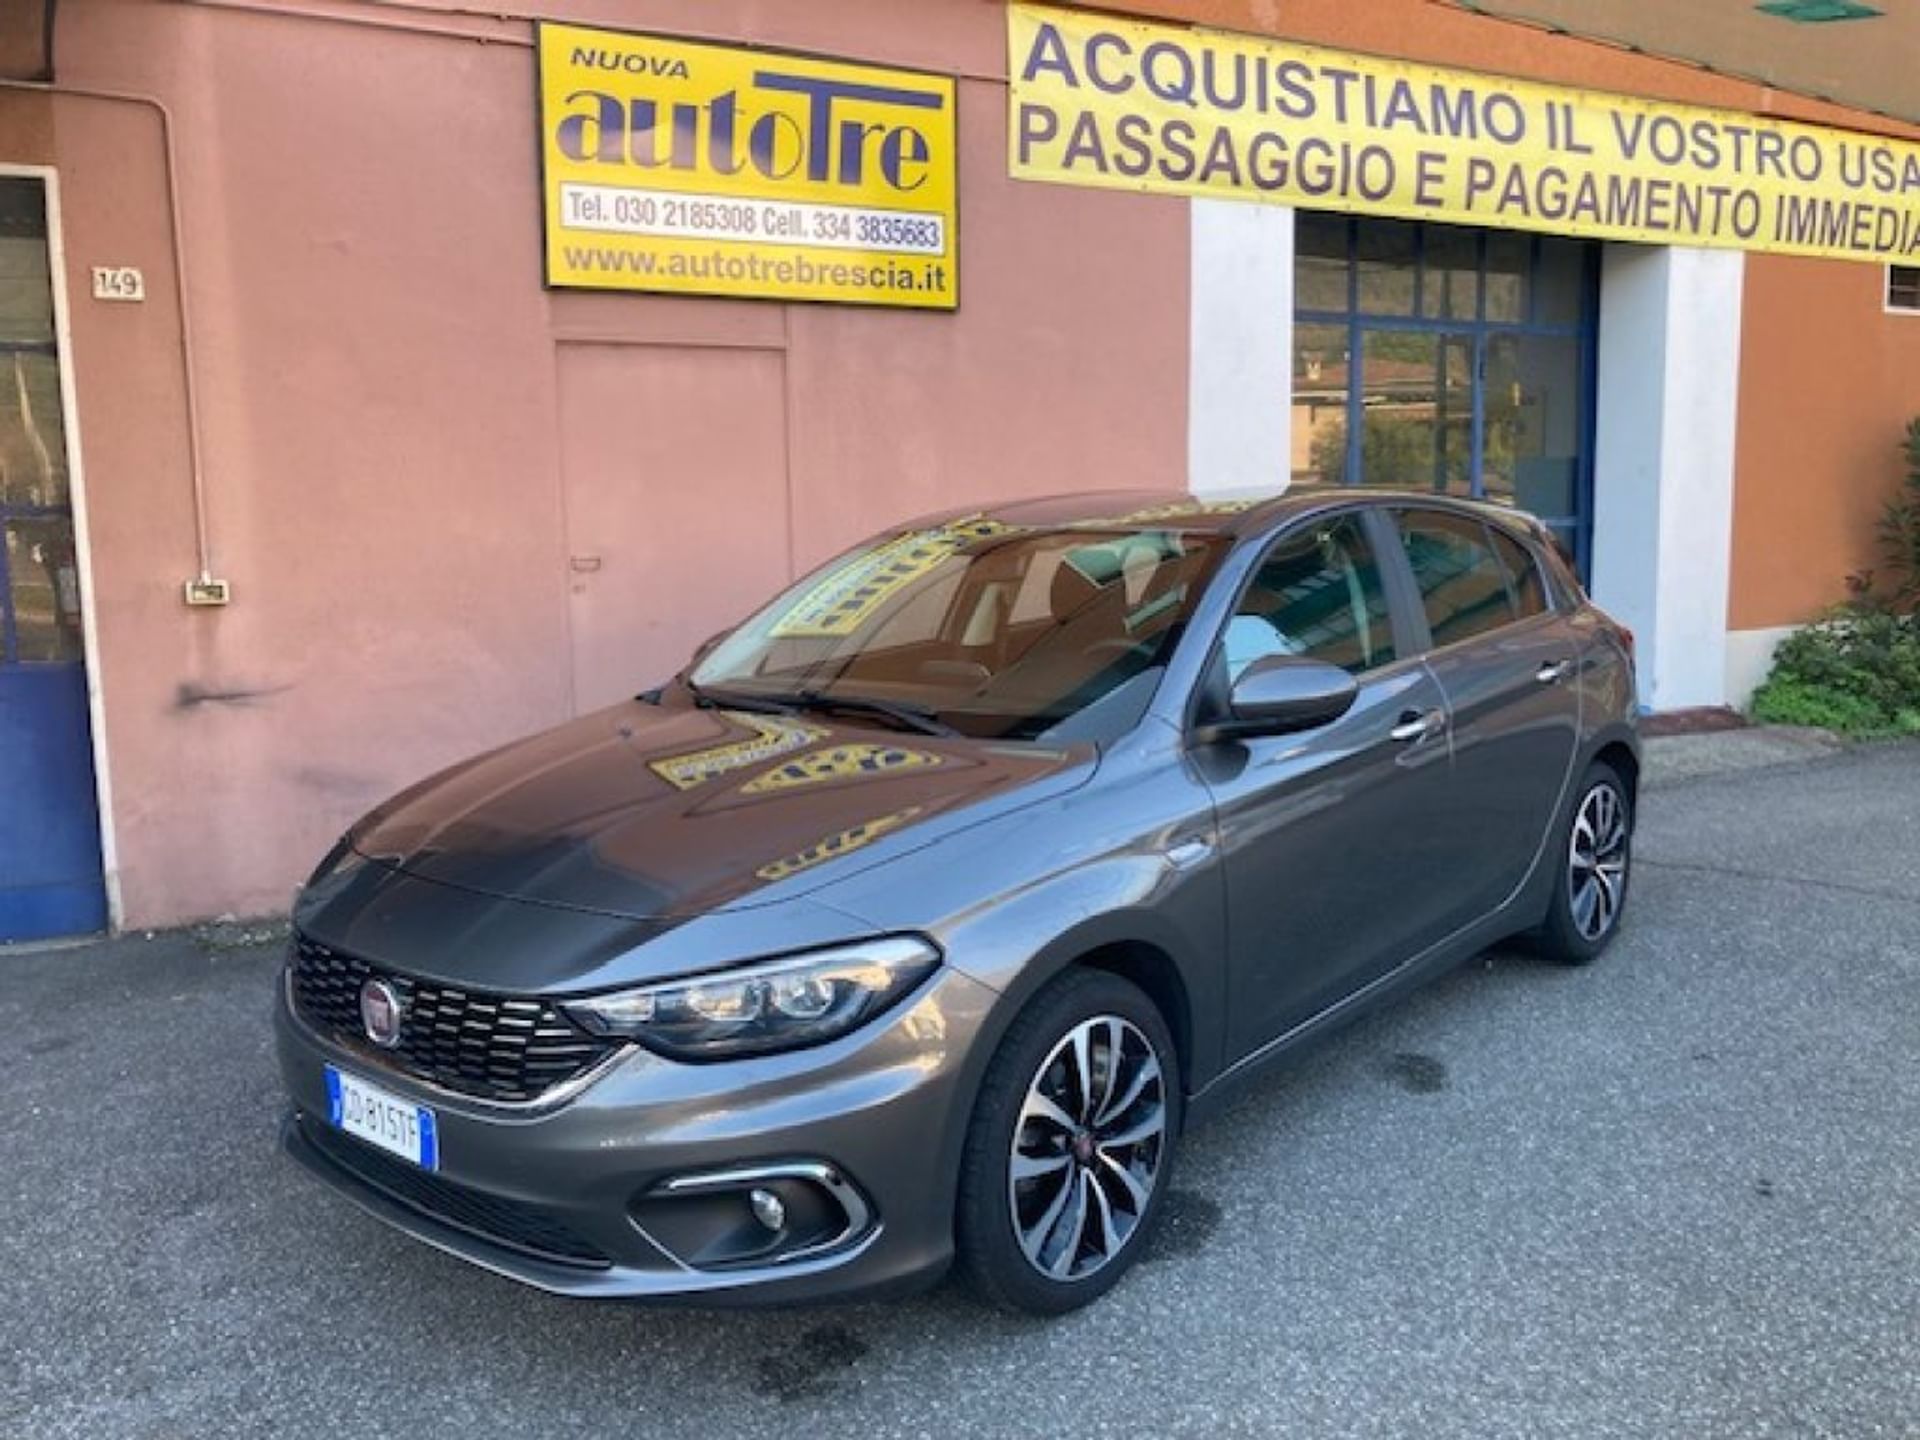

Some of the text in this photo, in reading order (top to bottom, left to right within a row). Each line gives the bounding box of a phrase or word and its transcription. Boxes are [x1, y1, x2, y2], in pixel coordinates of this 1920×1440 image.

[569, 46, 690, 79] NUOVA
[556, 70, 944, 192] autoTre
[1022, 22, 1920, 193] ACQUISTIAMO IL VOSTRO USA
[1018, 102, 1396, 202] PASSAGGIO
[1414, 150, 1447, 207] E
[1464, 157, 1761, 240] PAGAMENTO
[568, 190, 941, 248] Tel. 030 2185308 Cell. 334 3835683
[99, 272, 137, 295] 149
[563, 244, 946, 293] www.autotrebrescia.it
